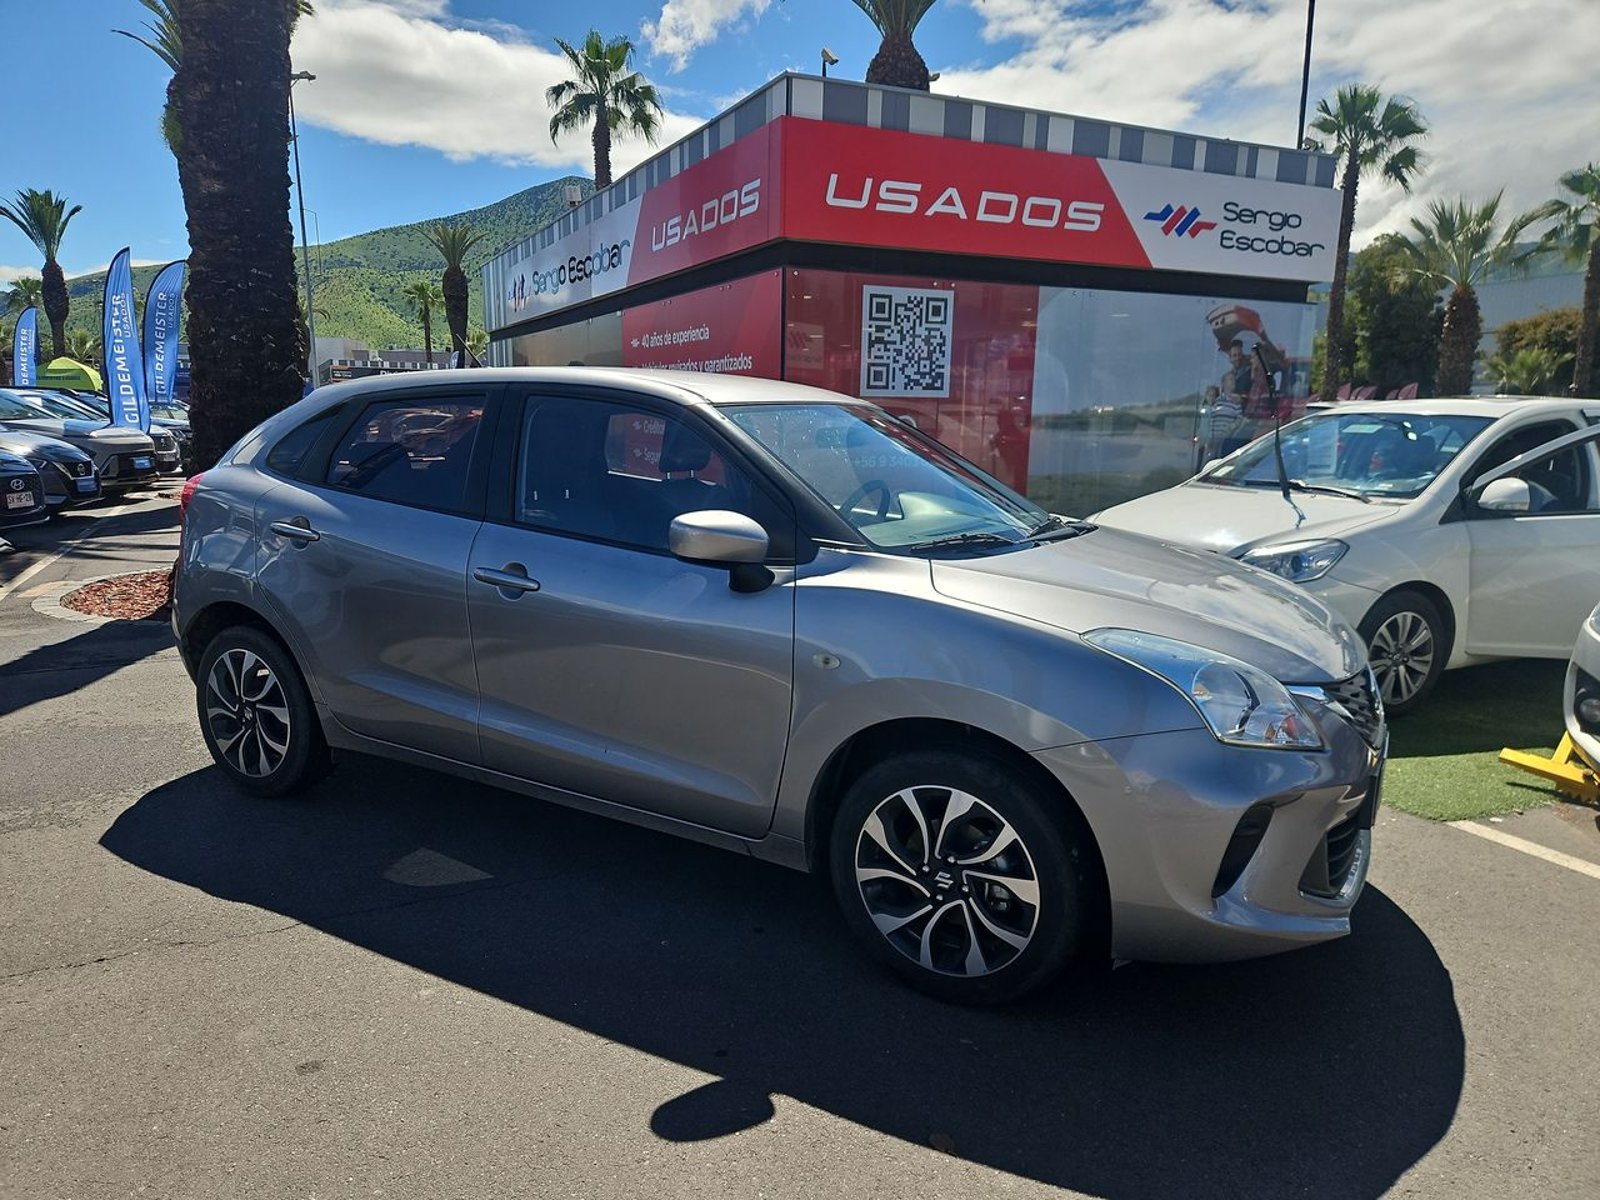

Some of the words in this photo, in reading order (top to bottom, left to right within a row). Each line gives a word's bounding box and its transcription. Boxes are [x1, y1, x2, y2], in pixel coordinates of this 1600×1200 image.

[651, 178, 761, 253] USADOS
[825, 173, 1105, 233] USADOS
[1223, 201, 1302, 232] Sergio
[568, 239, 631, 284] Escobar
[1220, 229, 1325, 257] Escobar
[121, 293, 131, 338] USADOS
[641, 336, 649, 349] 40
[650, 331, 663, 347] años
[664, 330, 672, 345] de
[672, 323, 710, 345] experiencia
[704, 352, 752, 372] garantizados
